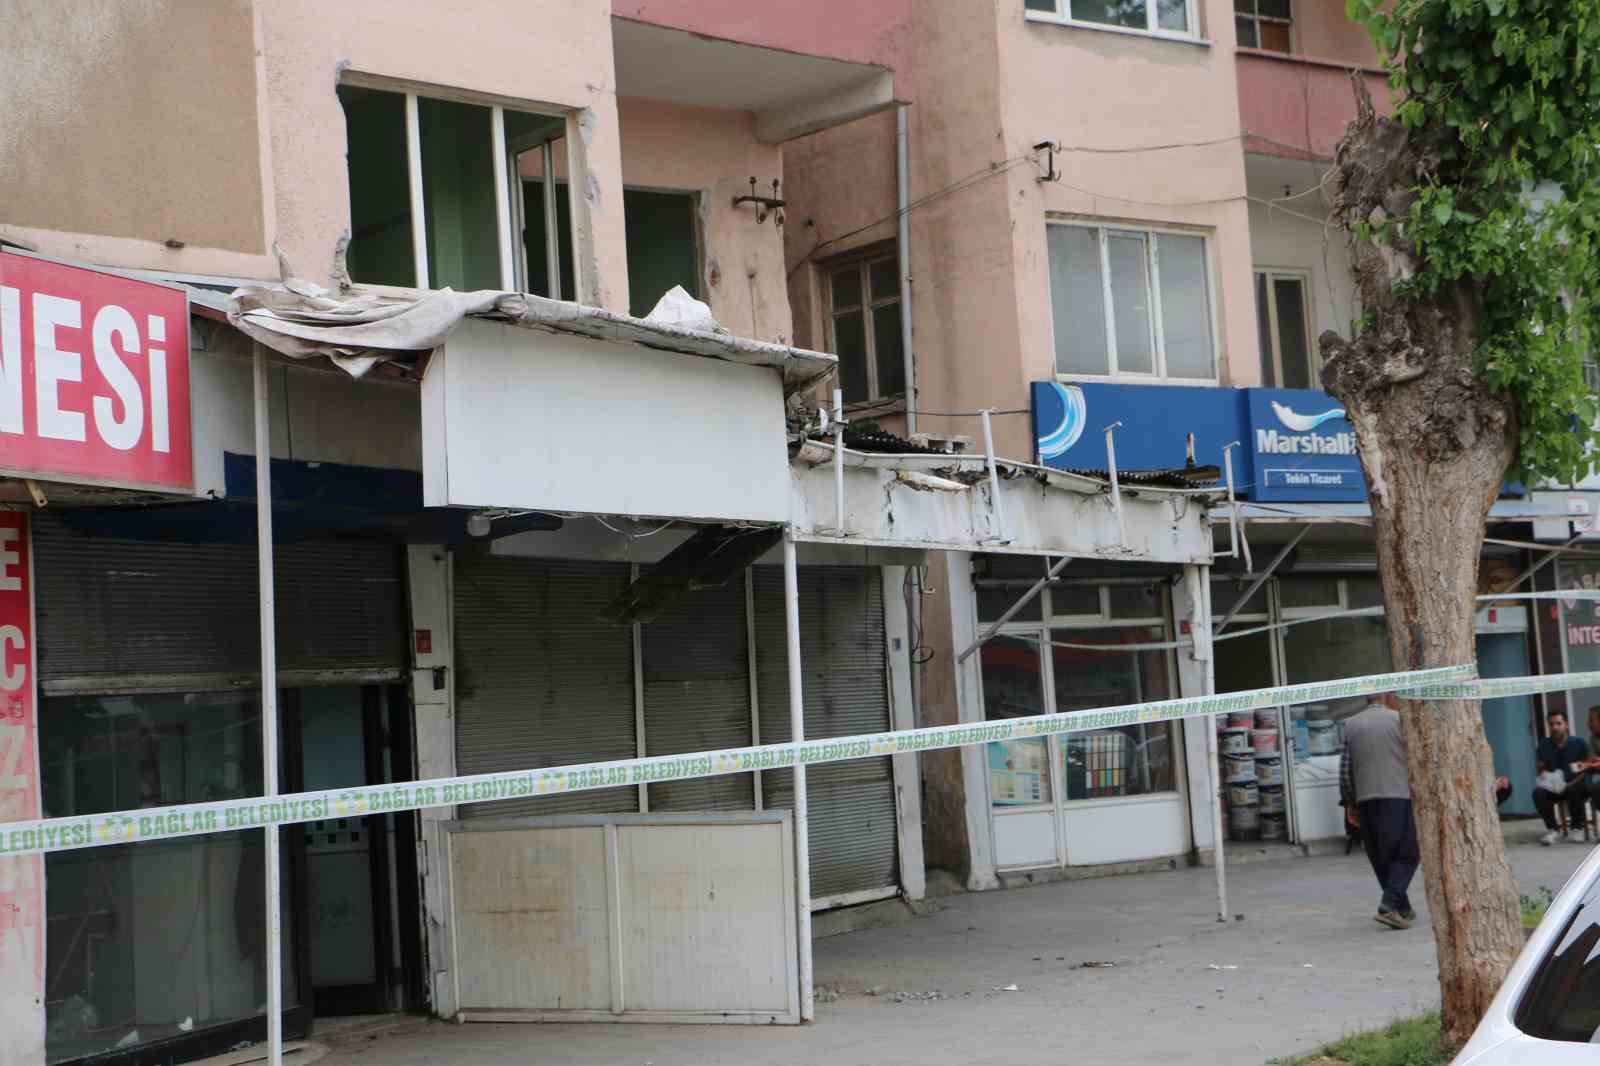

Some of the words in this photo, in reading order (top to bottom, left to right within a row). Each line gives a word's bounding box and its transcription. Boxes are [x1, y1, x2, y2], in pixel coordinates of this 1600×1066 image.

[1310, 473, 1342, 484] Ticaret
[139, 809, 216, 836] BAĞLAR
[225, 795, 328, 827] BELEDİYESİ
[369, 785, 436, 811] BAĞLAR
[443, 773, 532, 803] BELEDİYESİ
[568, 766, 627, 790] BAĞLAR
[632, 757, 712, 781] BELEDİYESİ
[742, 745, 795, 768] BAĞLAR
[800, 739, 870, 762] BELEDİYESİ
